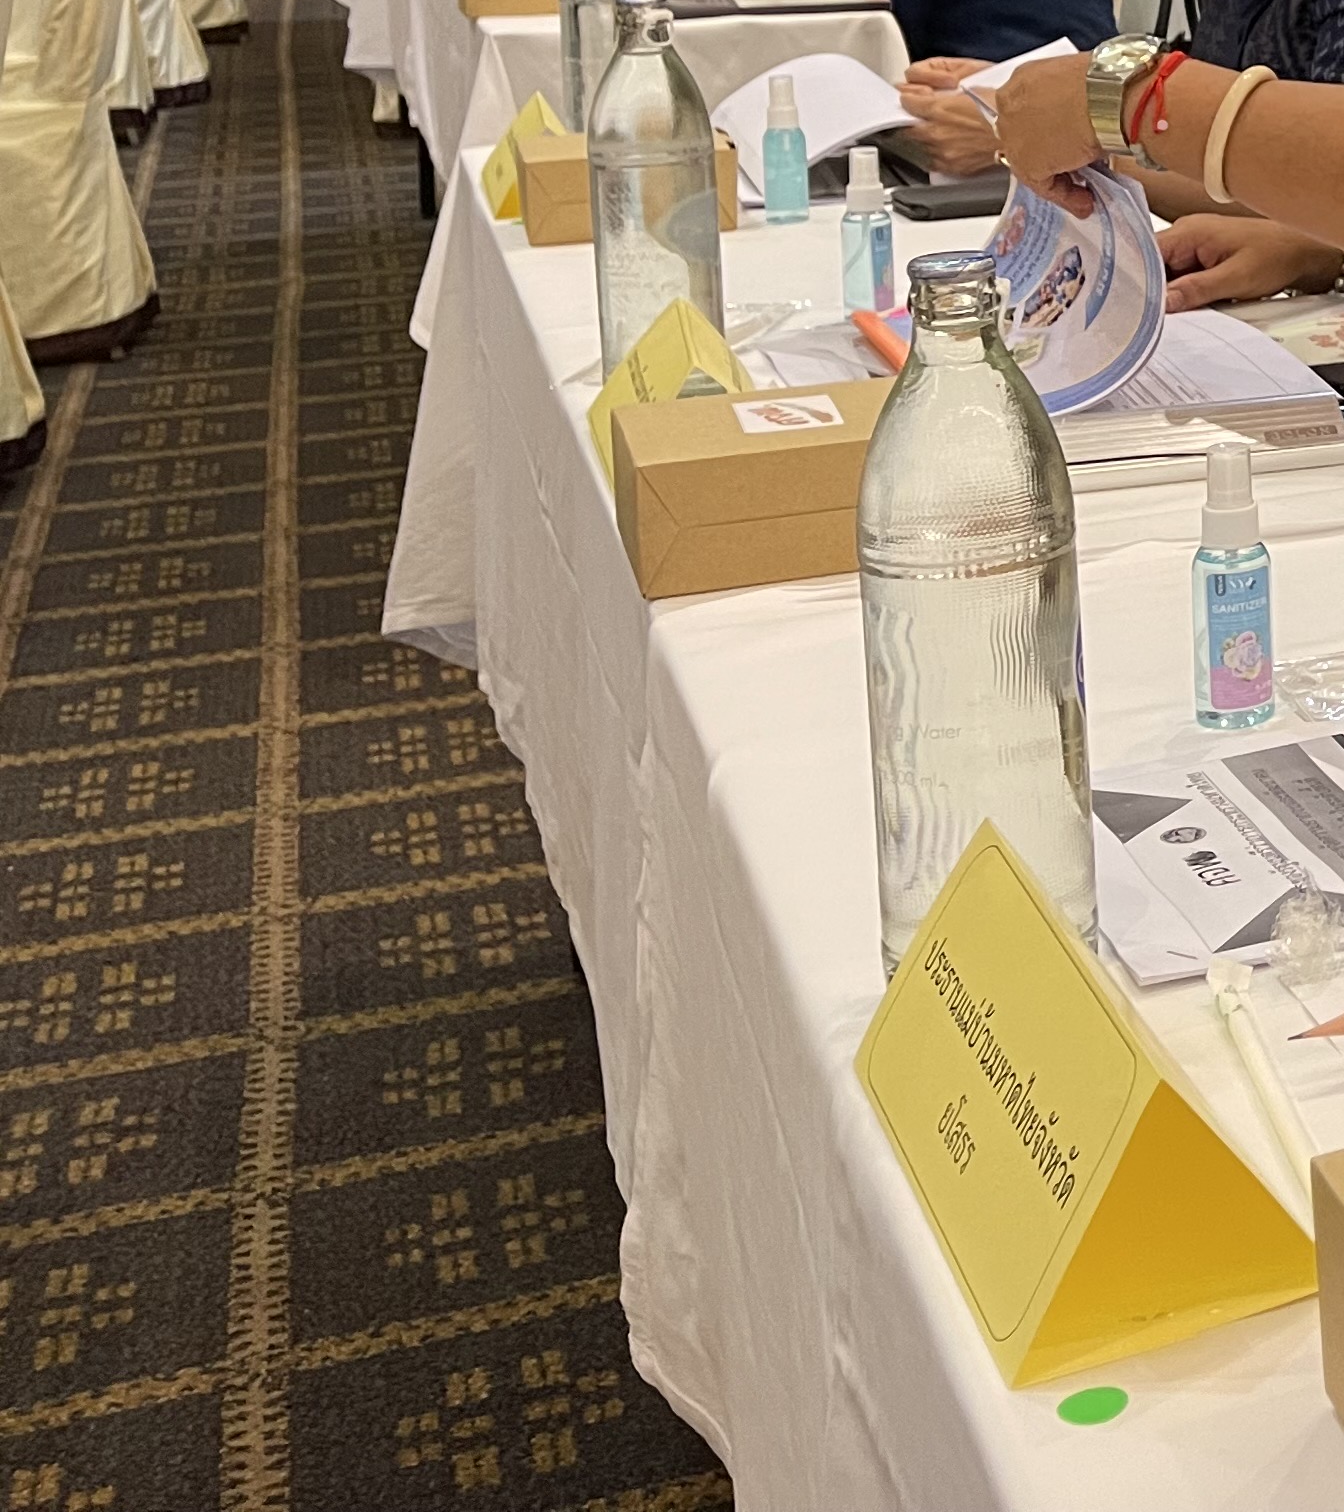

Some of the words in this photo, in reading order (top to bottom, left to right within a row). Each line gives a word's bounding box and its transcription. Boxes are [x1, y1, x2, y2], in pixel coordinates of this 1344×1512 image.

[1211, 596, 1267, 615] SANITIZER
[908, 722, 962, 740] Water
[924, 937, 1080, 1211] ประธานแม่บ้านมหาดไทยจังหวัด
[938, 1094, 976, 1176] ยโสธร
